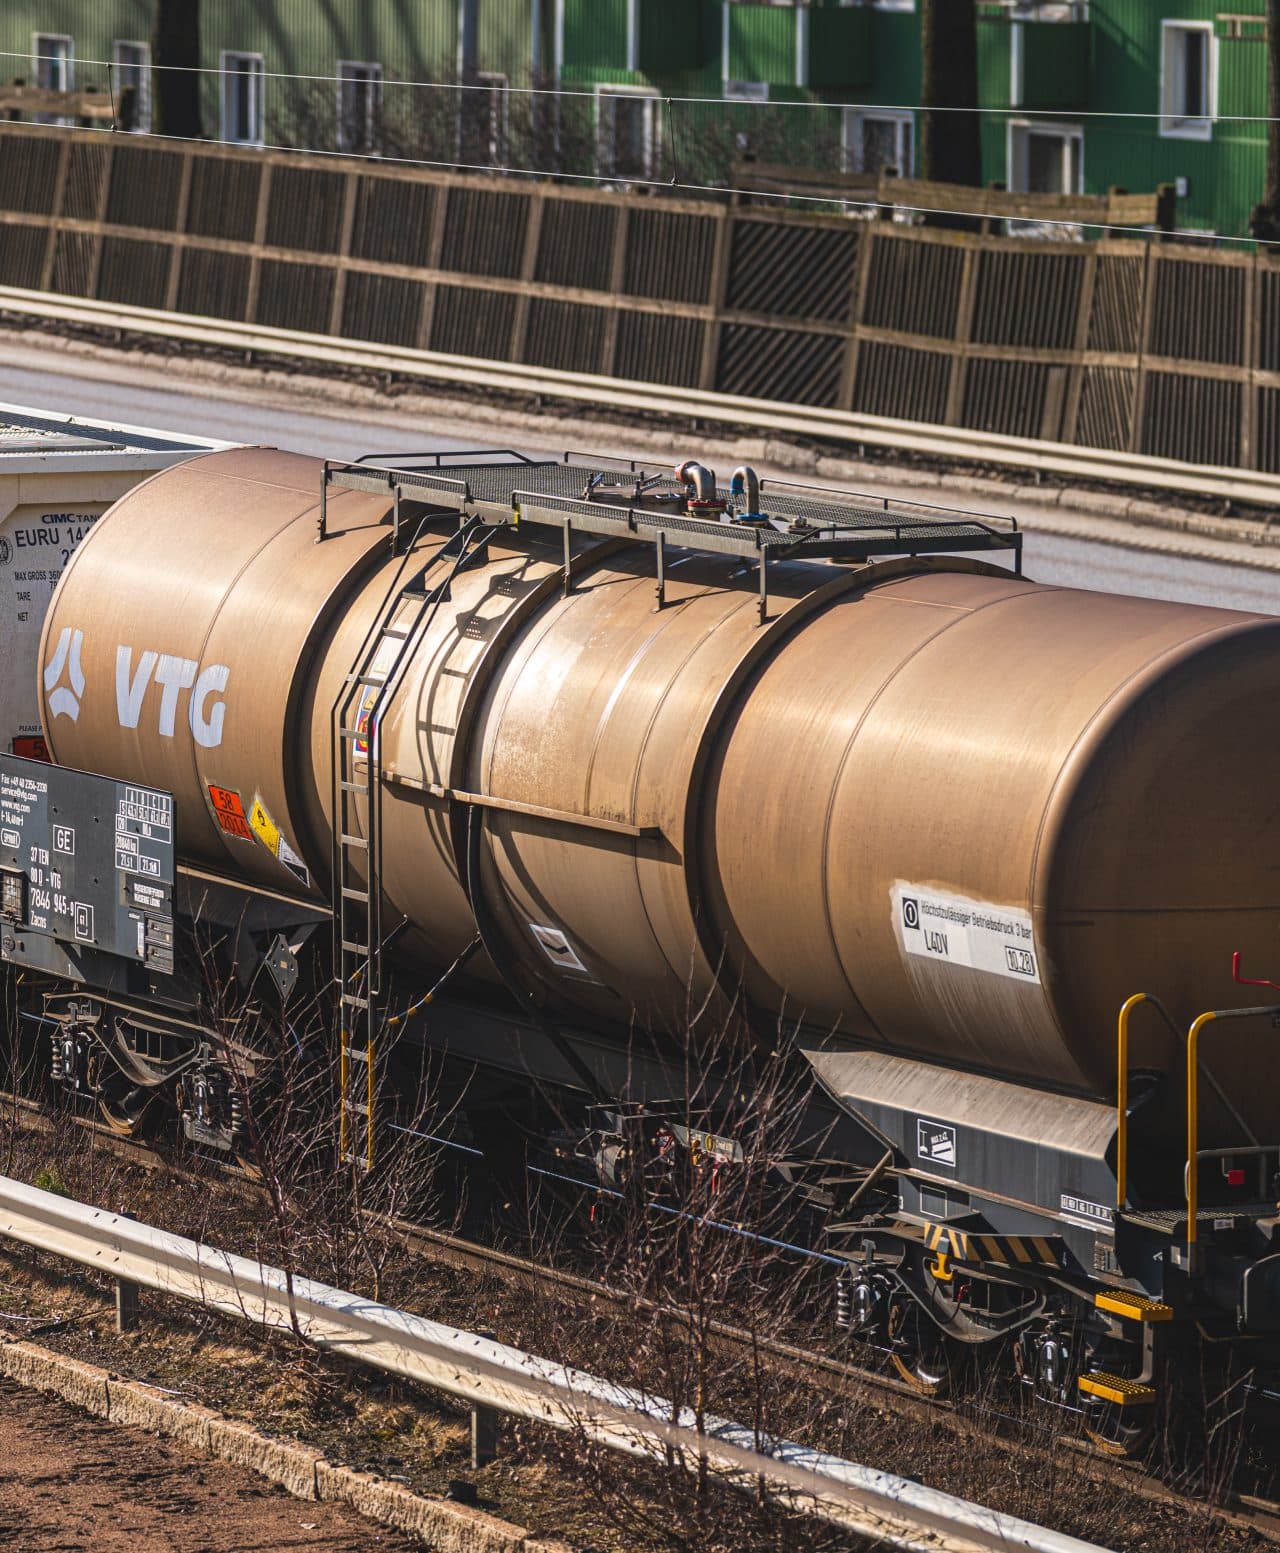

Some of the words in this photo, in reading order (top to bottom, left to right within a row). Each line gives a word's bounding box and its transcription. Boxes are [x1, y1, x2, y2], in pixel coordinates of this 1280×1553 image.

[42, 513, 75, 524] CIMC
[15, 527, 59, 547] EURU
[15, 571, 27, 581] MAX
[28, 570, 47, 581] GROSS
[17, 591, 31, 601] TARE
[17, 612, 29, 622] NET
[115, 645, 231, 748] VTG
[1, 774, 10, 785] Fax
[219, 791, 234, 811] 58
[220, 813, 250, 835] 2014
[57, 829, 71, 850] GE
[30, 846, 37, 862] 37
[38, 848, 50, 865] TEN
[30, 867, 37, 883] 80
[50, 872, 61, 889] VTG
[31, 888, 50, 910] 7846
[54, 894, 74, 917] 945-9
[31, 911, 47, 928] Zacns
[921, 900, 971, 927] Höchstzulässiger
[972, 912, 1014, 936] Betriebsdruck
[1015, 919, 1020, 936] 3
[1020, 923, 1032, 939] bar
